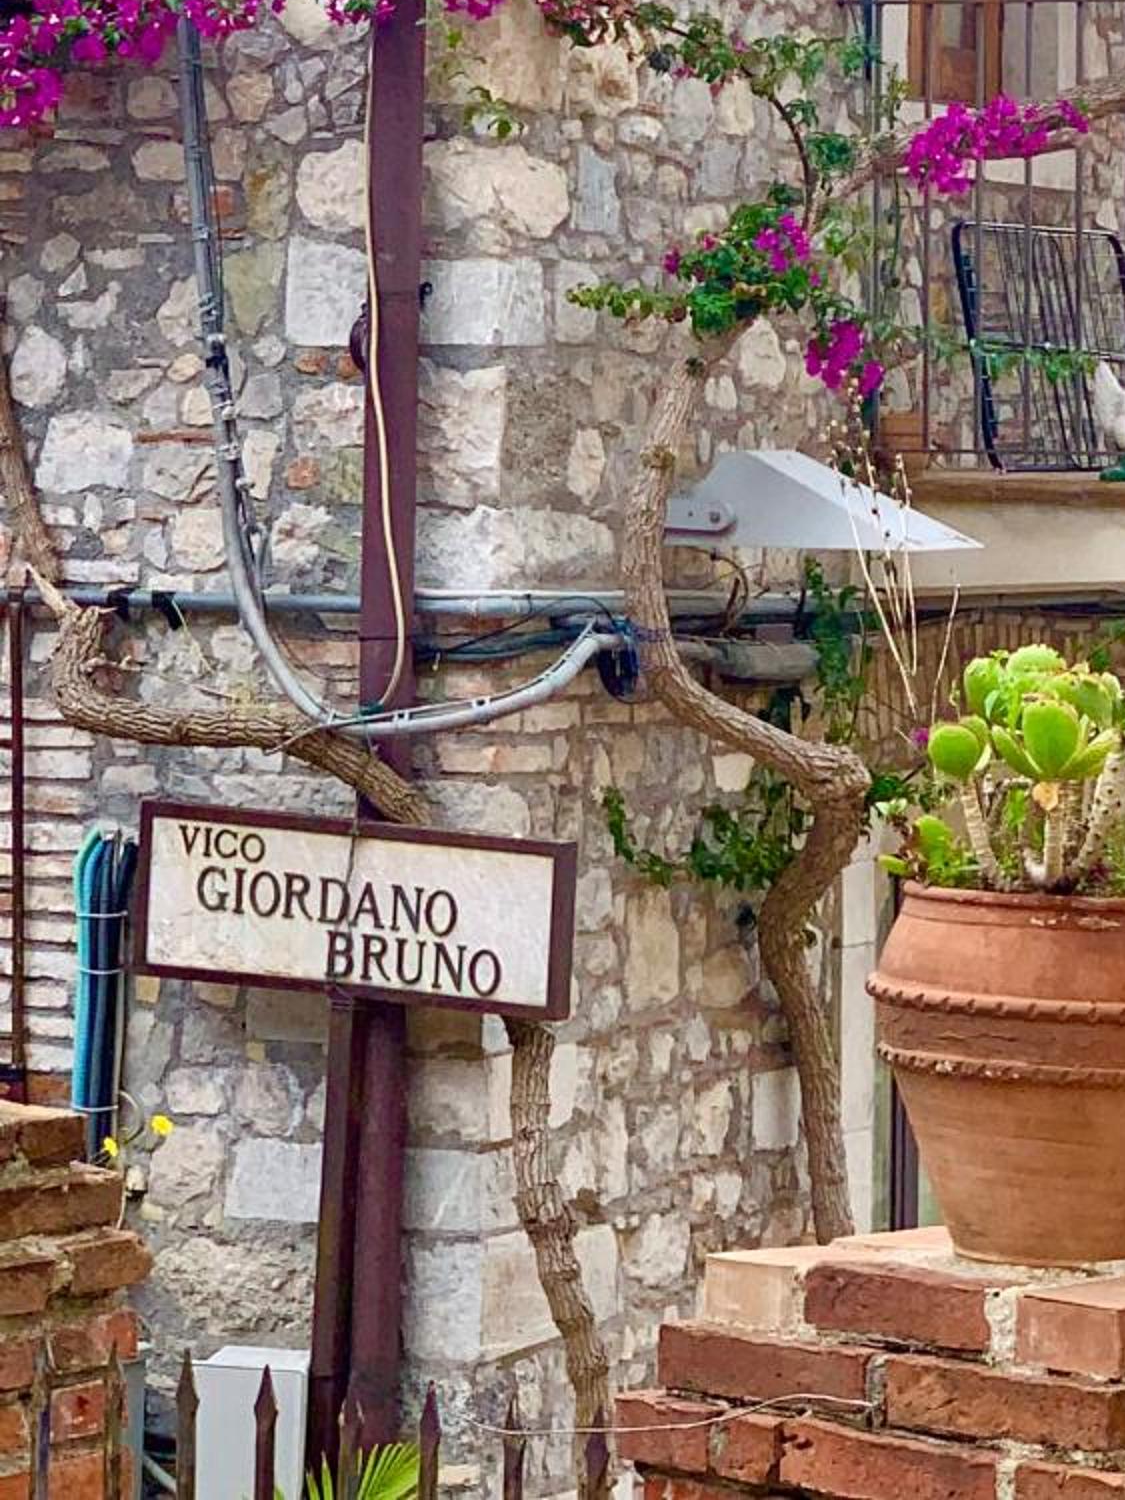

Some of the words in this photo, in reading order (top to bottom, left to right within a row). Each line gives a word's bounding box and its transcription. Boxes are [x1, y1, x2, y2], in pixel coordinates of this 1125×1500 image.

[178, 824, 266, 864] VICO
[196, 865, 460, 938] GIORDANO
[324, 929, 503, 997] BRUNO
